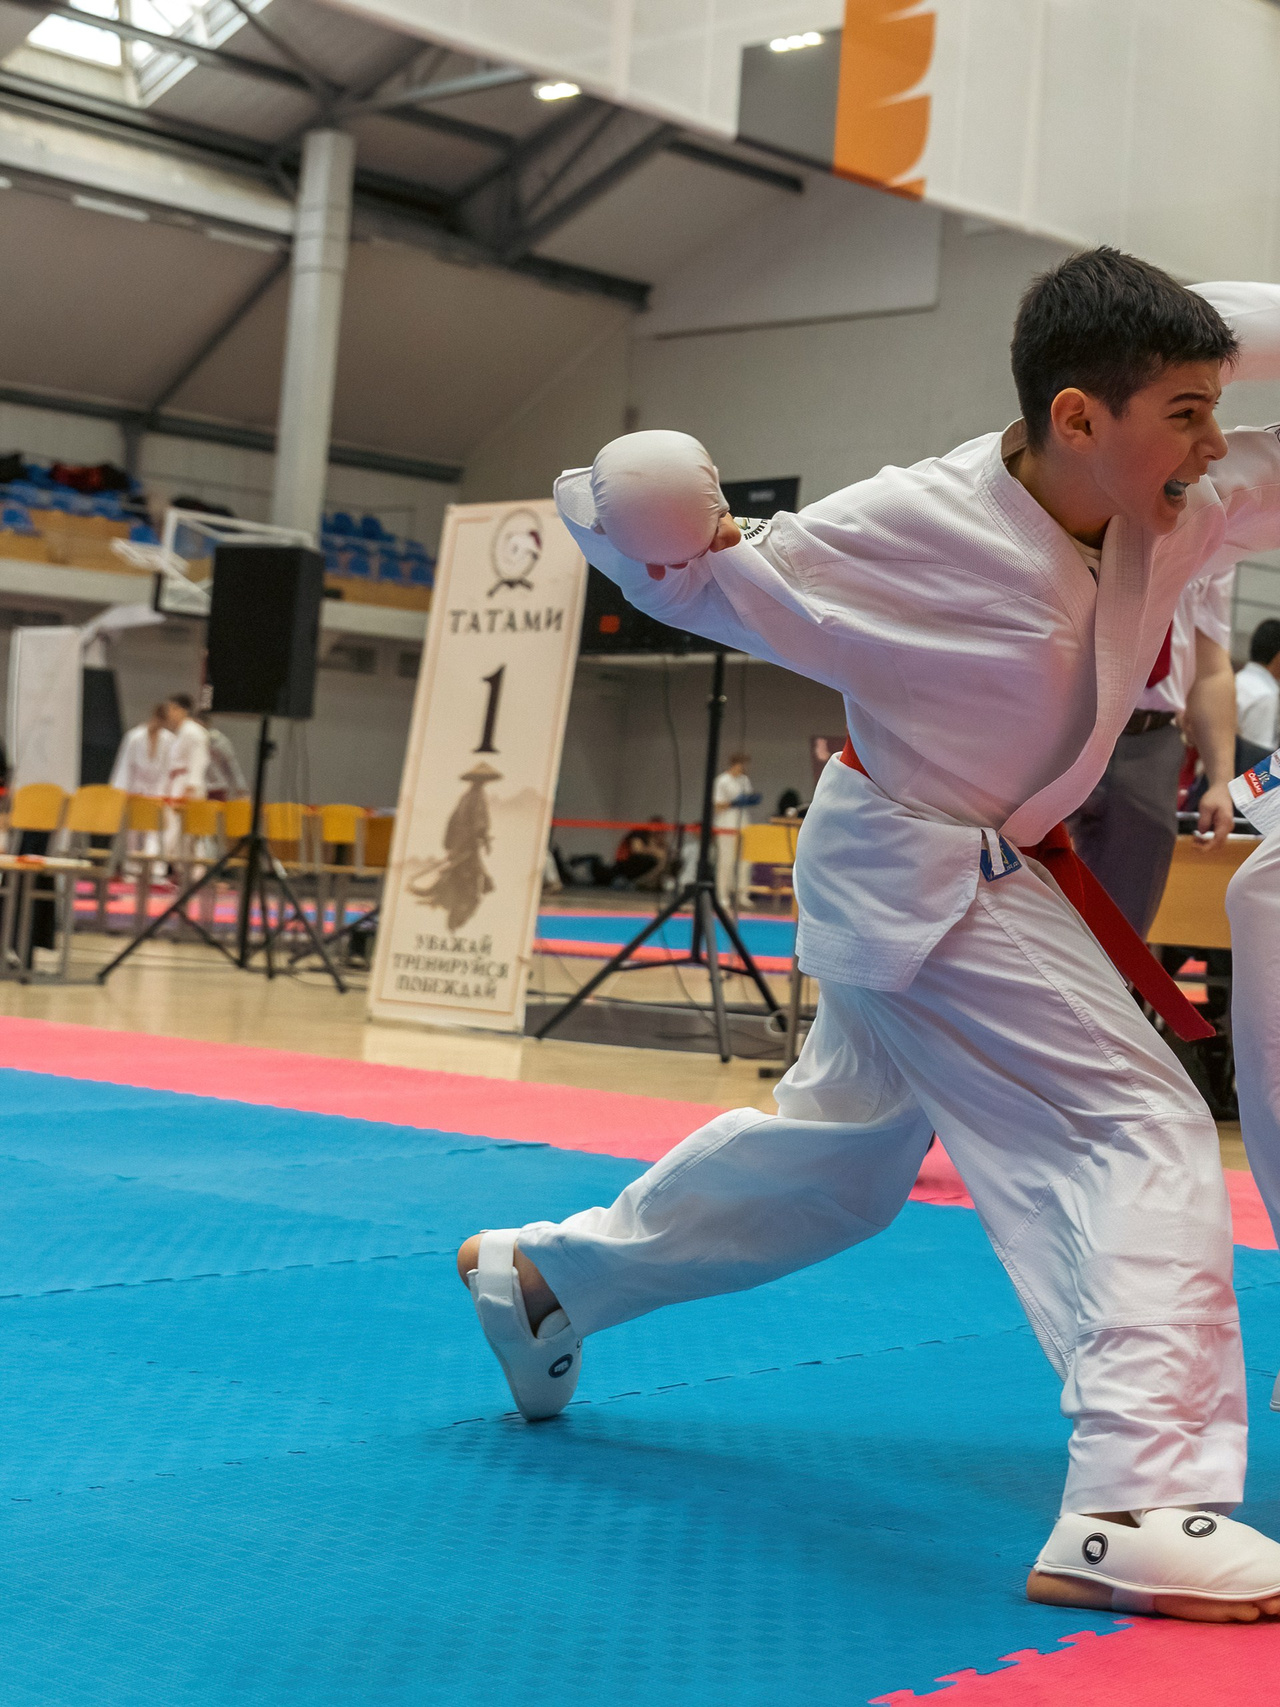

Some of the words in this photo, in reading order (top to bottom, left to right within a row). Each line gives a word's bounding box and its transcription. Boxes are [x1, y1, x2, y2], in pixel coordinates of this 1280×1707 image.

[448, 608, 564, 634] ТАТАМИ
[472, 663, 507, 753] 1
[414, 932, 493, 956] УВАЖАЙ
[393, 952, 509, 979] ТРЕНИРУЙСЯ
